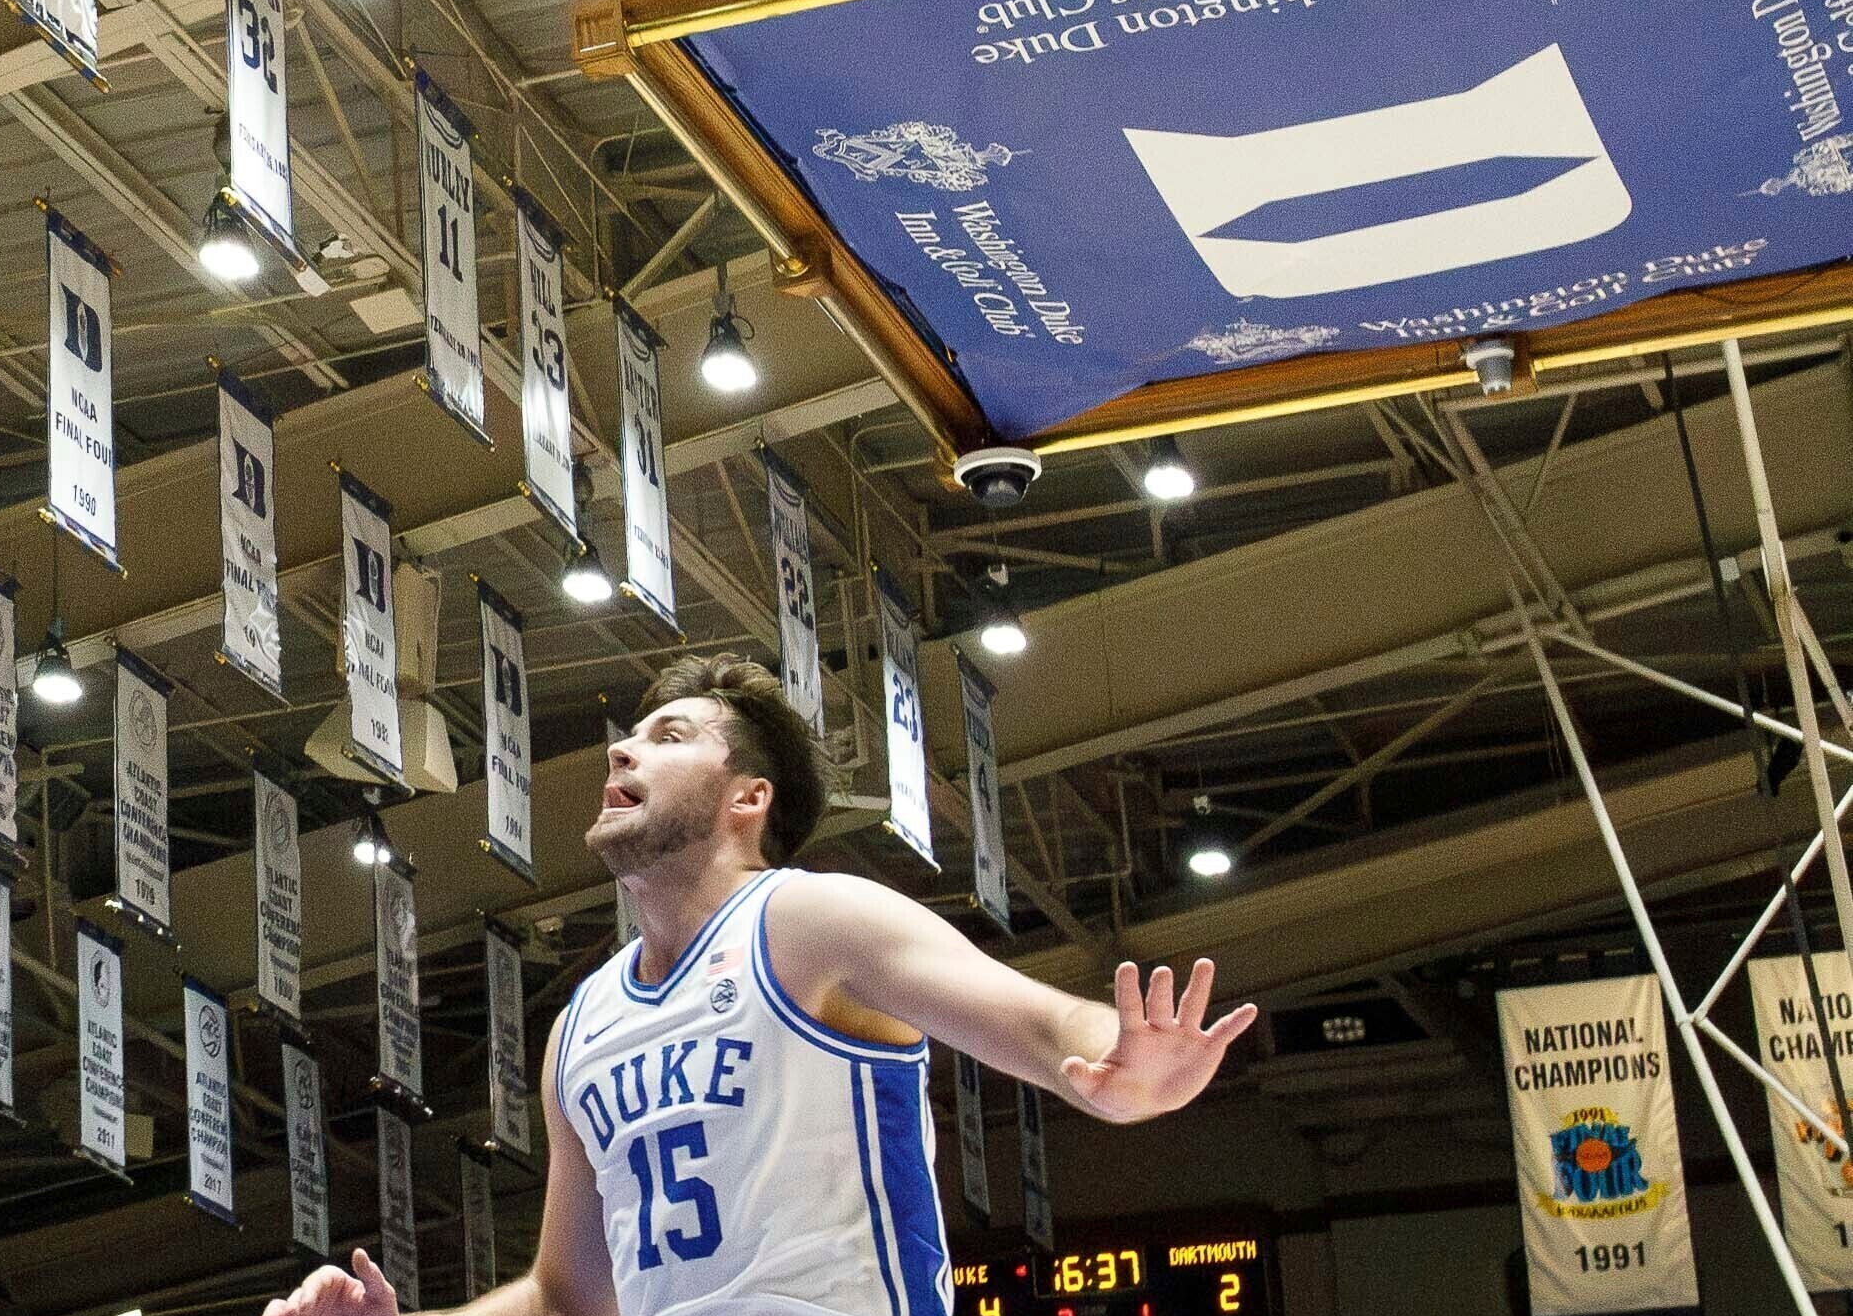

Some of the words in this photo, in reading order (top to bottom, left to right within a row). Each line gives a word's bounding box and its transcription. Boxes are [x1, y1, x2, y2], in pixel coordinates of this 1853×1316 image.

[970, 20, 1109, 65] Duke
[895, 209, 940, 244] Inn
[952, 200, 1047, 295] Washington
[1029, 301, 1085, 344] Duke
[55, 412, 83, 449] FINAL
[1524, 1017, 1644, 1054] NATIONAL
[1514, 1052, 1660, 1091] CHAMPIONS
[578, 1036, 754, 1152] DUKE
[626, 1120, 723, 1272] 15
[1055, 1251, 1140, 1292] 16:37
[1169, 1241, 1256, 1266] DARTMOUTH
[1574, 1241, 1645, 1272] 1991
[1220, 1274, 1240, 1311] 2
